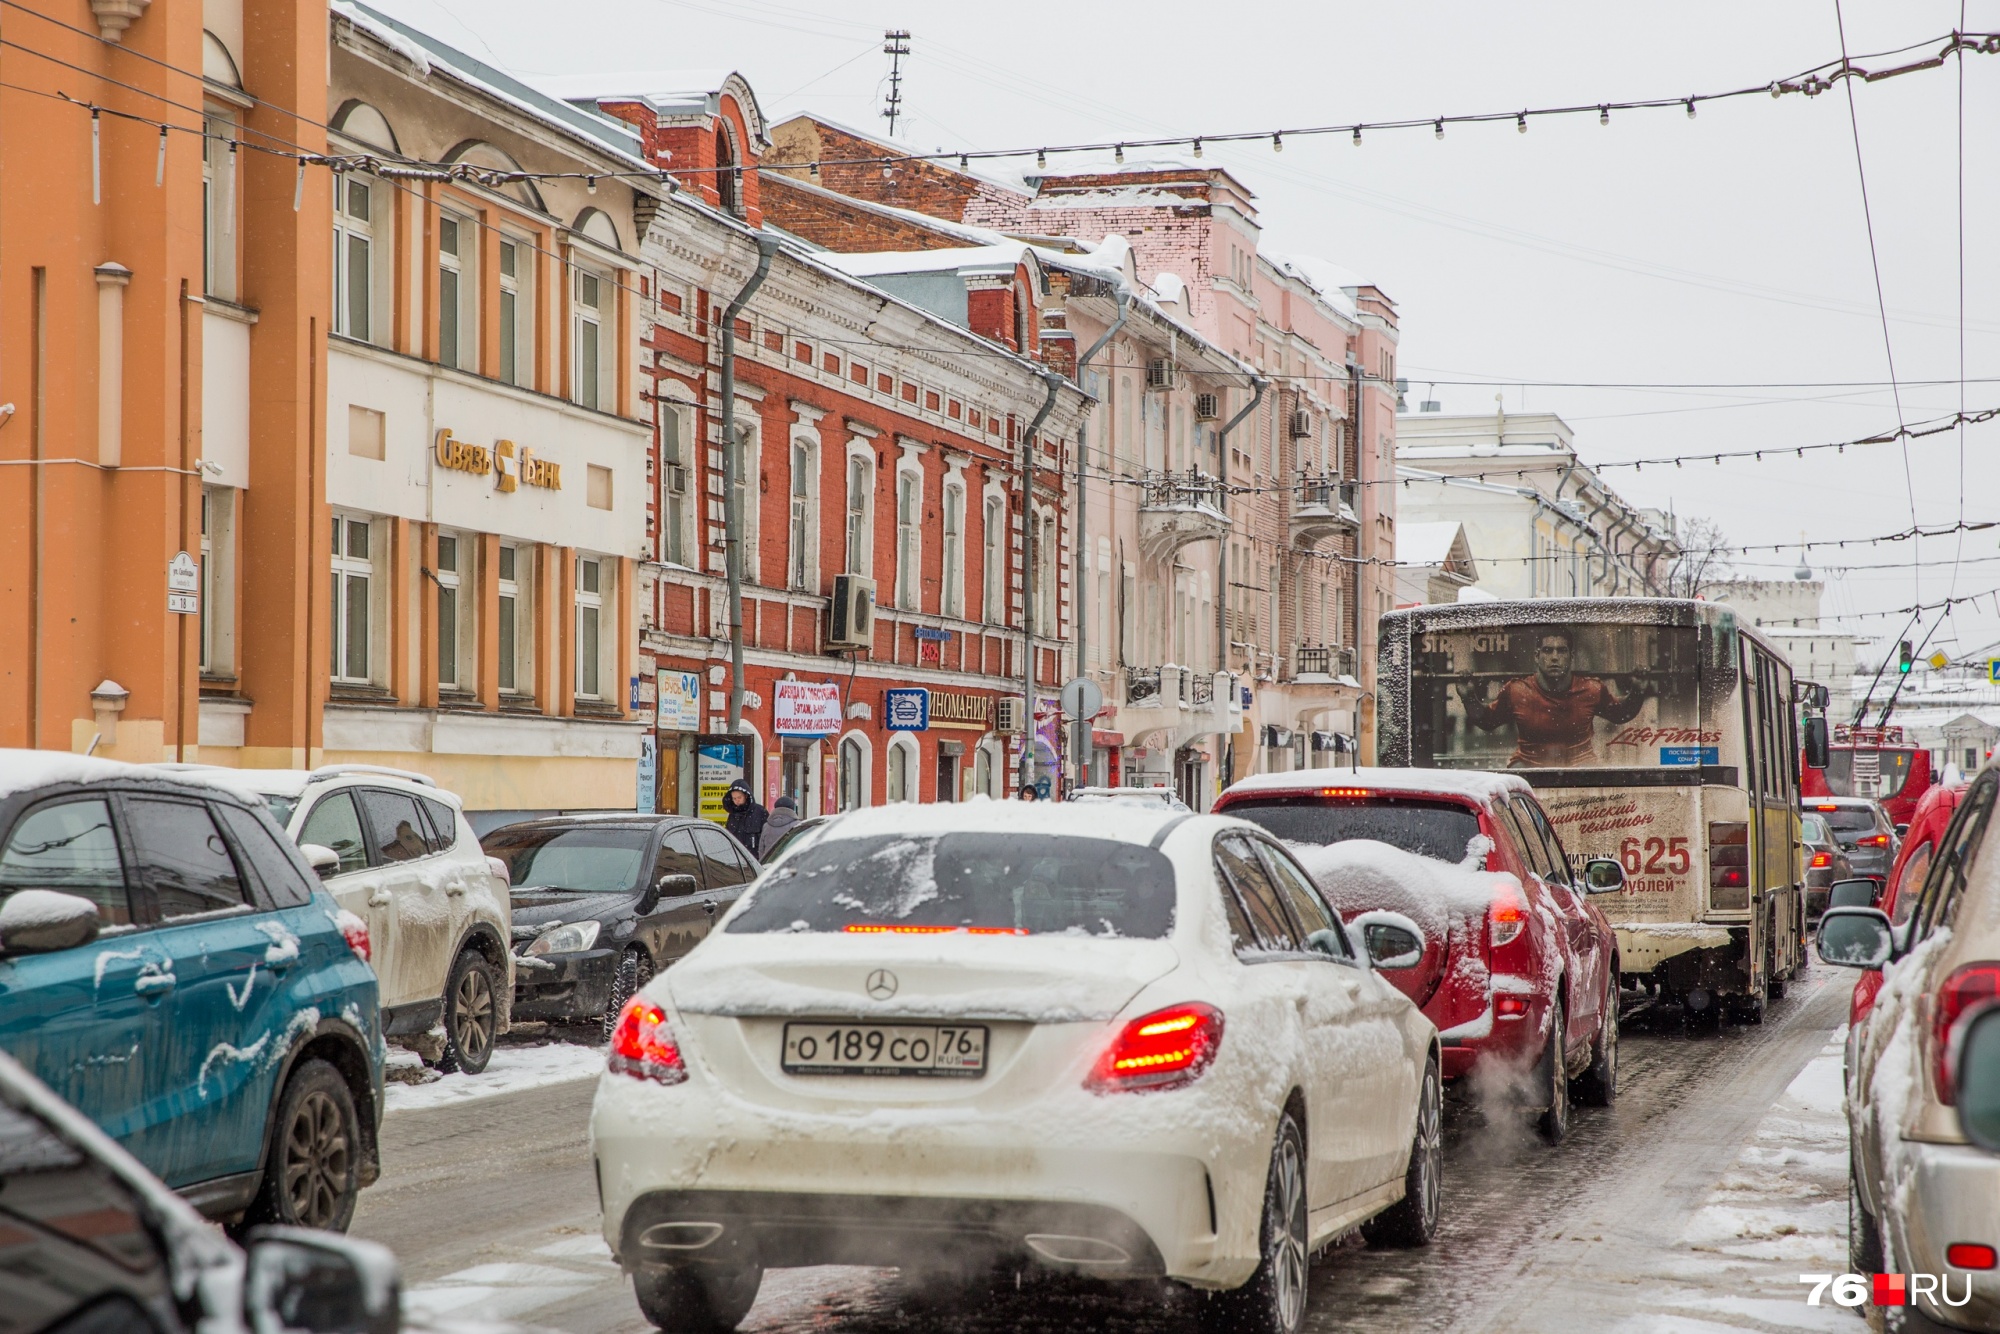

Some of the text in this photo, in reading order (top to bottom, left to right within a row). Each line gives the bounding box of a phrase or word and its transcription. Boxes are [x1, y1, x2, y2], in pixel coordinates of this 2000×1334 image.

[435, 428, 492, 475] Связь
[520, 446, 561, 491] Банк
[180, 597, 187, 609] 18
[915, 627, 952, 641] АВТОШКОЛА
[921, 642, 939, 661] РУСЬ
[779, 685, 799, 700] АРЕНДА
[928, 691, 988, 720] ИНОМАНИЯ
[1579, 813, 1655, 834] чемпион
[1620, 836, 1690, 876] 625
[941, 1030, 972, 1054] 76
[937, 1056, 961, 1065] RUS
